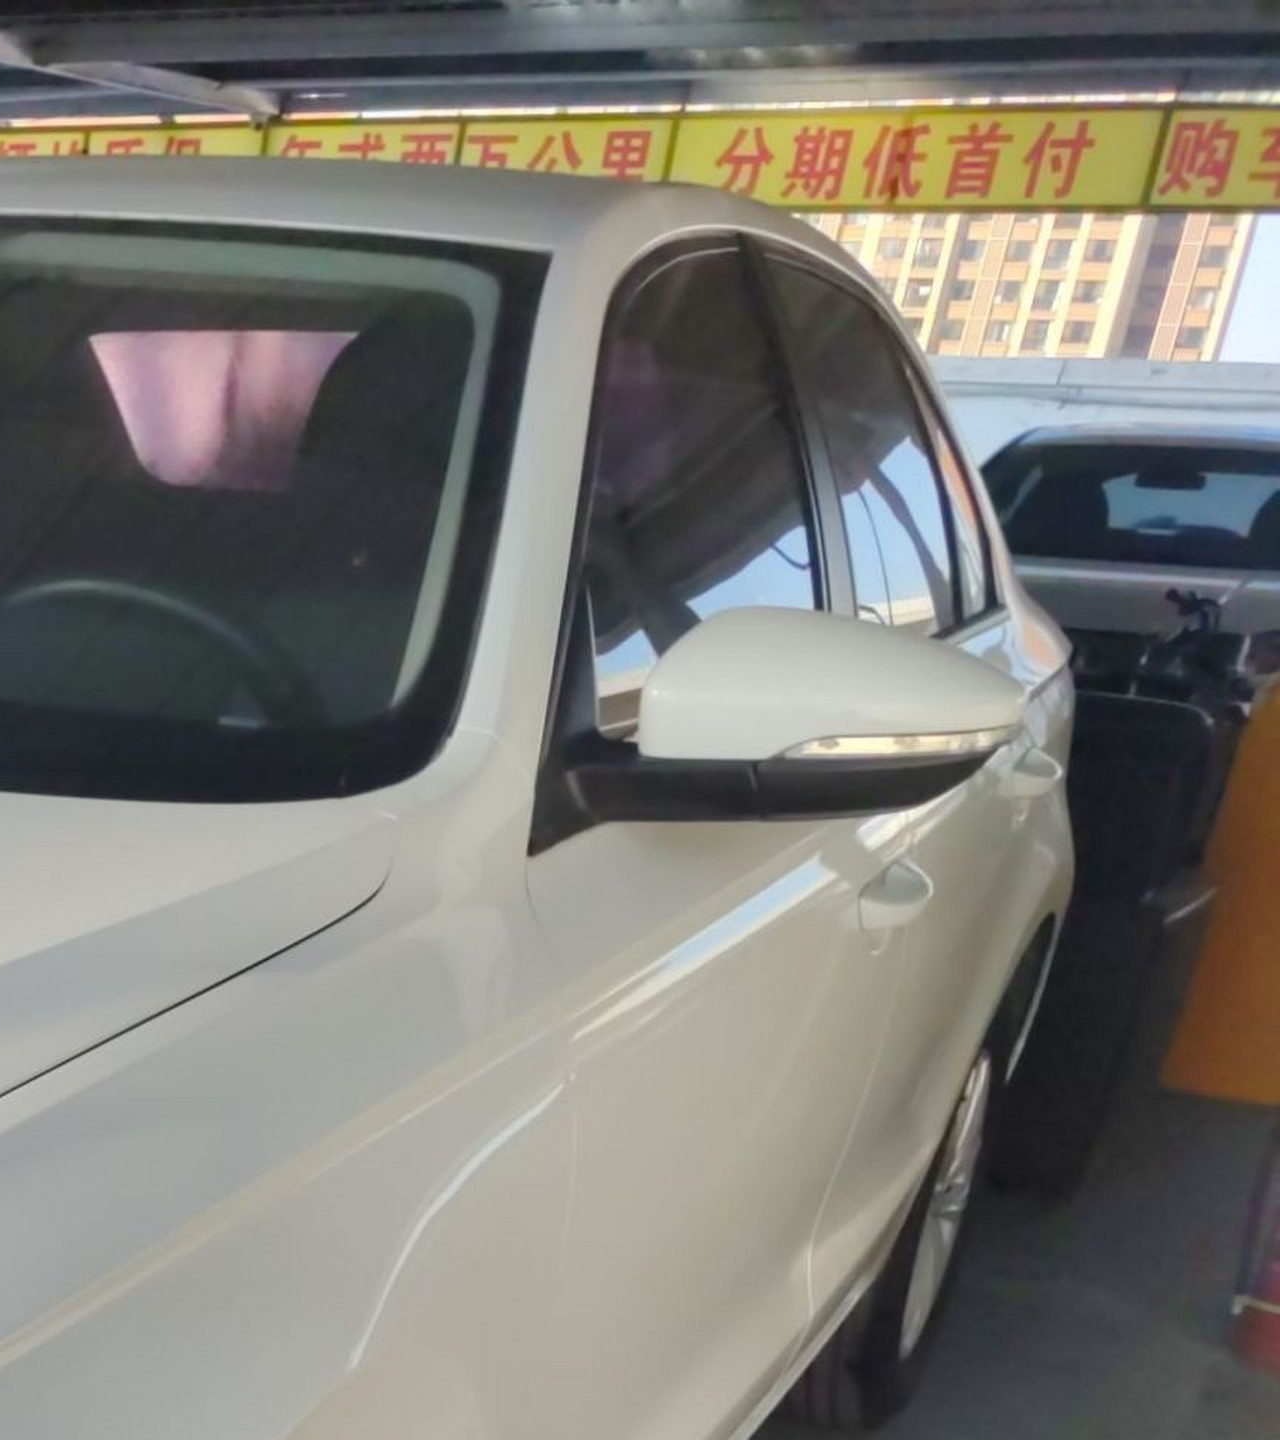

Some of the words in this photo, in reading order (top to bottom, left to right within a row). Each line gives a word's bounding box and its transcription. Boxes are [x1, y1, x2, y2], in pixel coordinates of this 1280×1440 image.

[714, 120, 1094, 198] 分期低首付
